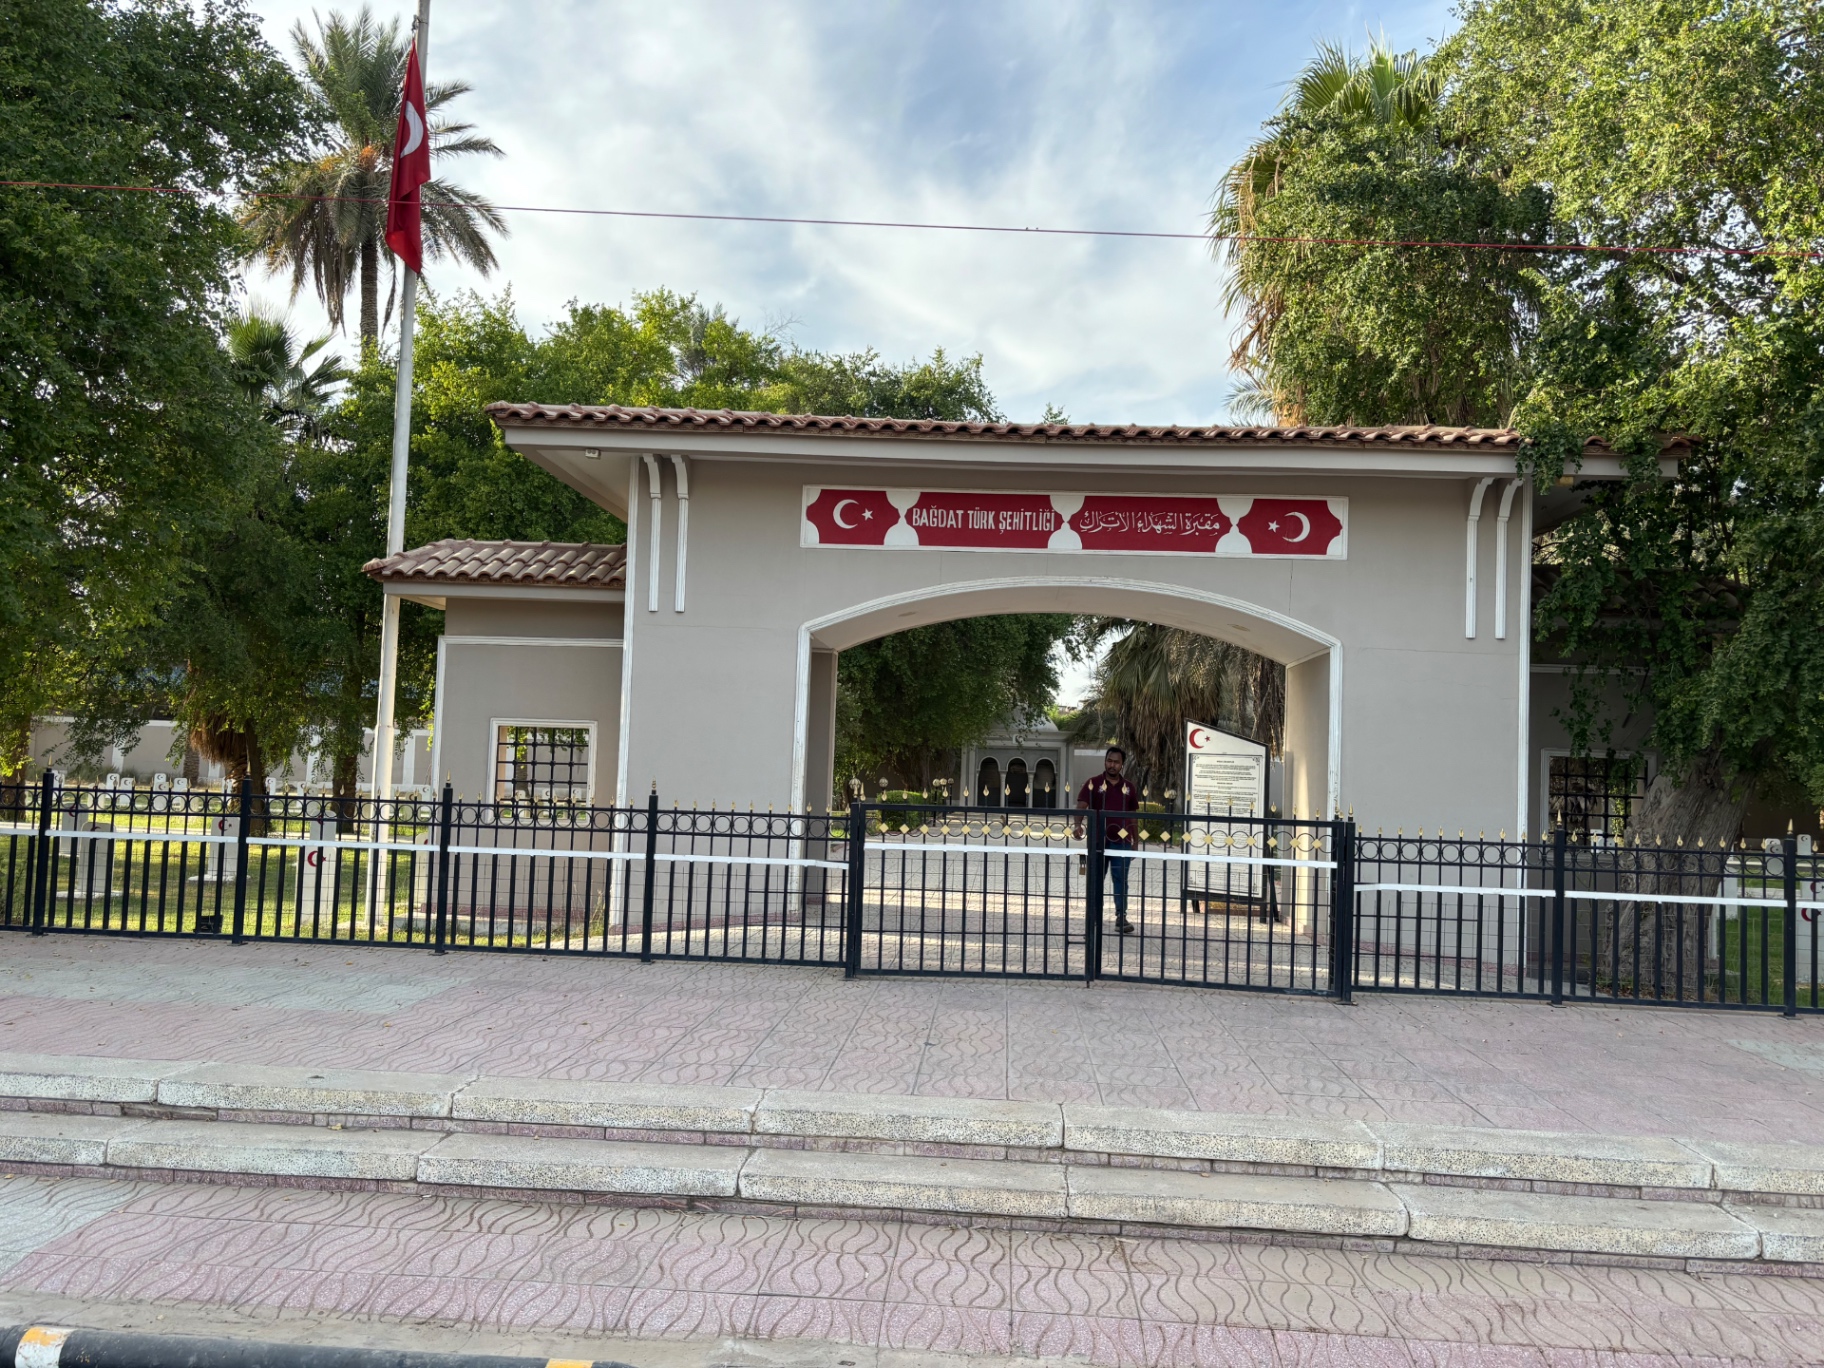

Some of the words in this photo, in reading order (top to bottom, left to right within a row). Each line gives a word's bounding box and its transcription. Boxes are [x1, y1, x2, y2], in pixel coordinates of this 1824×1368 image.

[912, 505, 964, 529] BAĞDAT
[967, 506, 996, 530] TÜRK
[998, 508, 1056, 535] ŞEHİTLİĞİ
